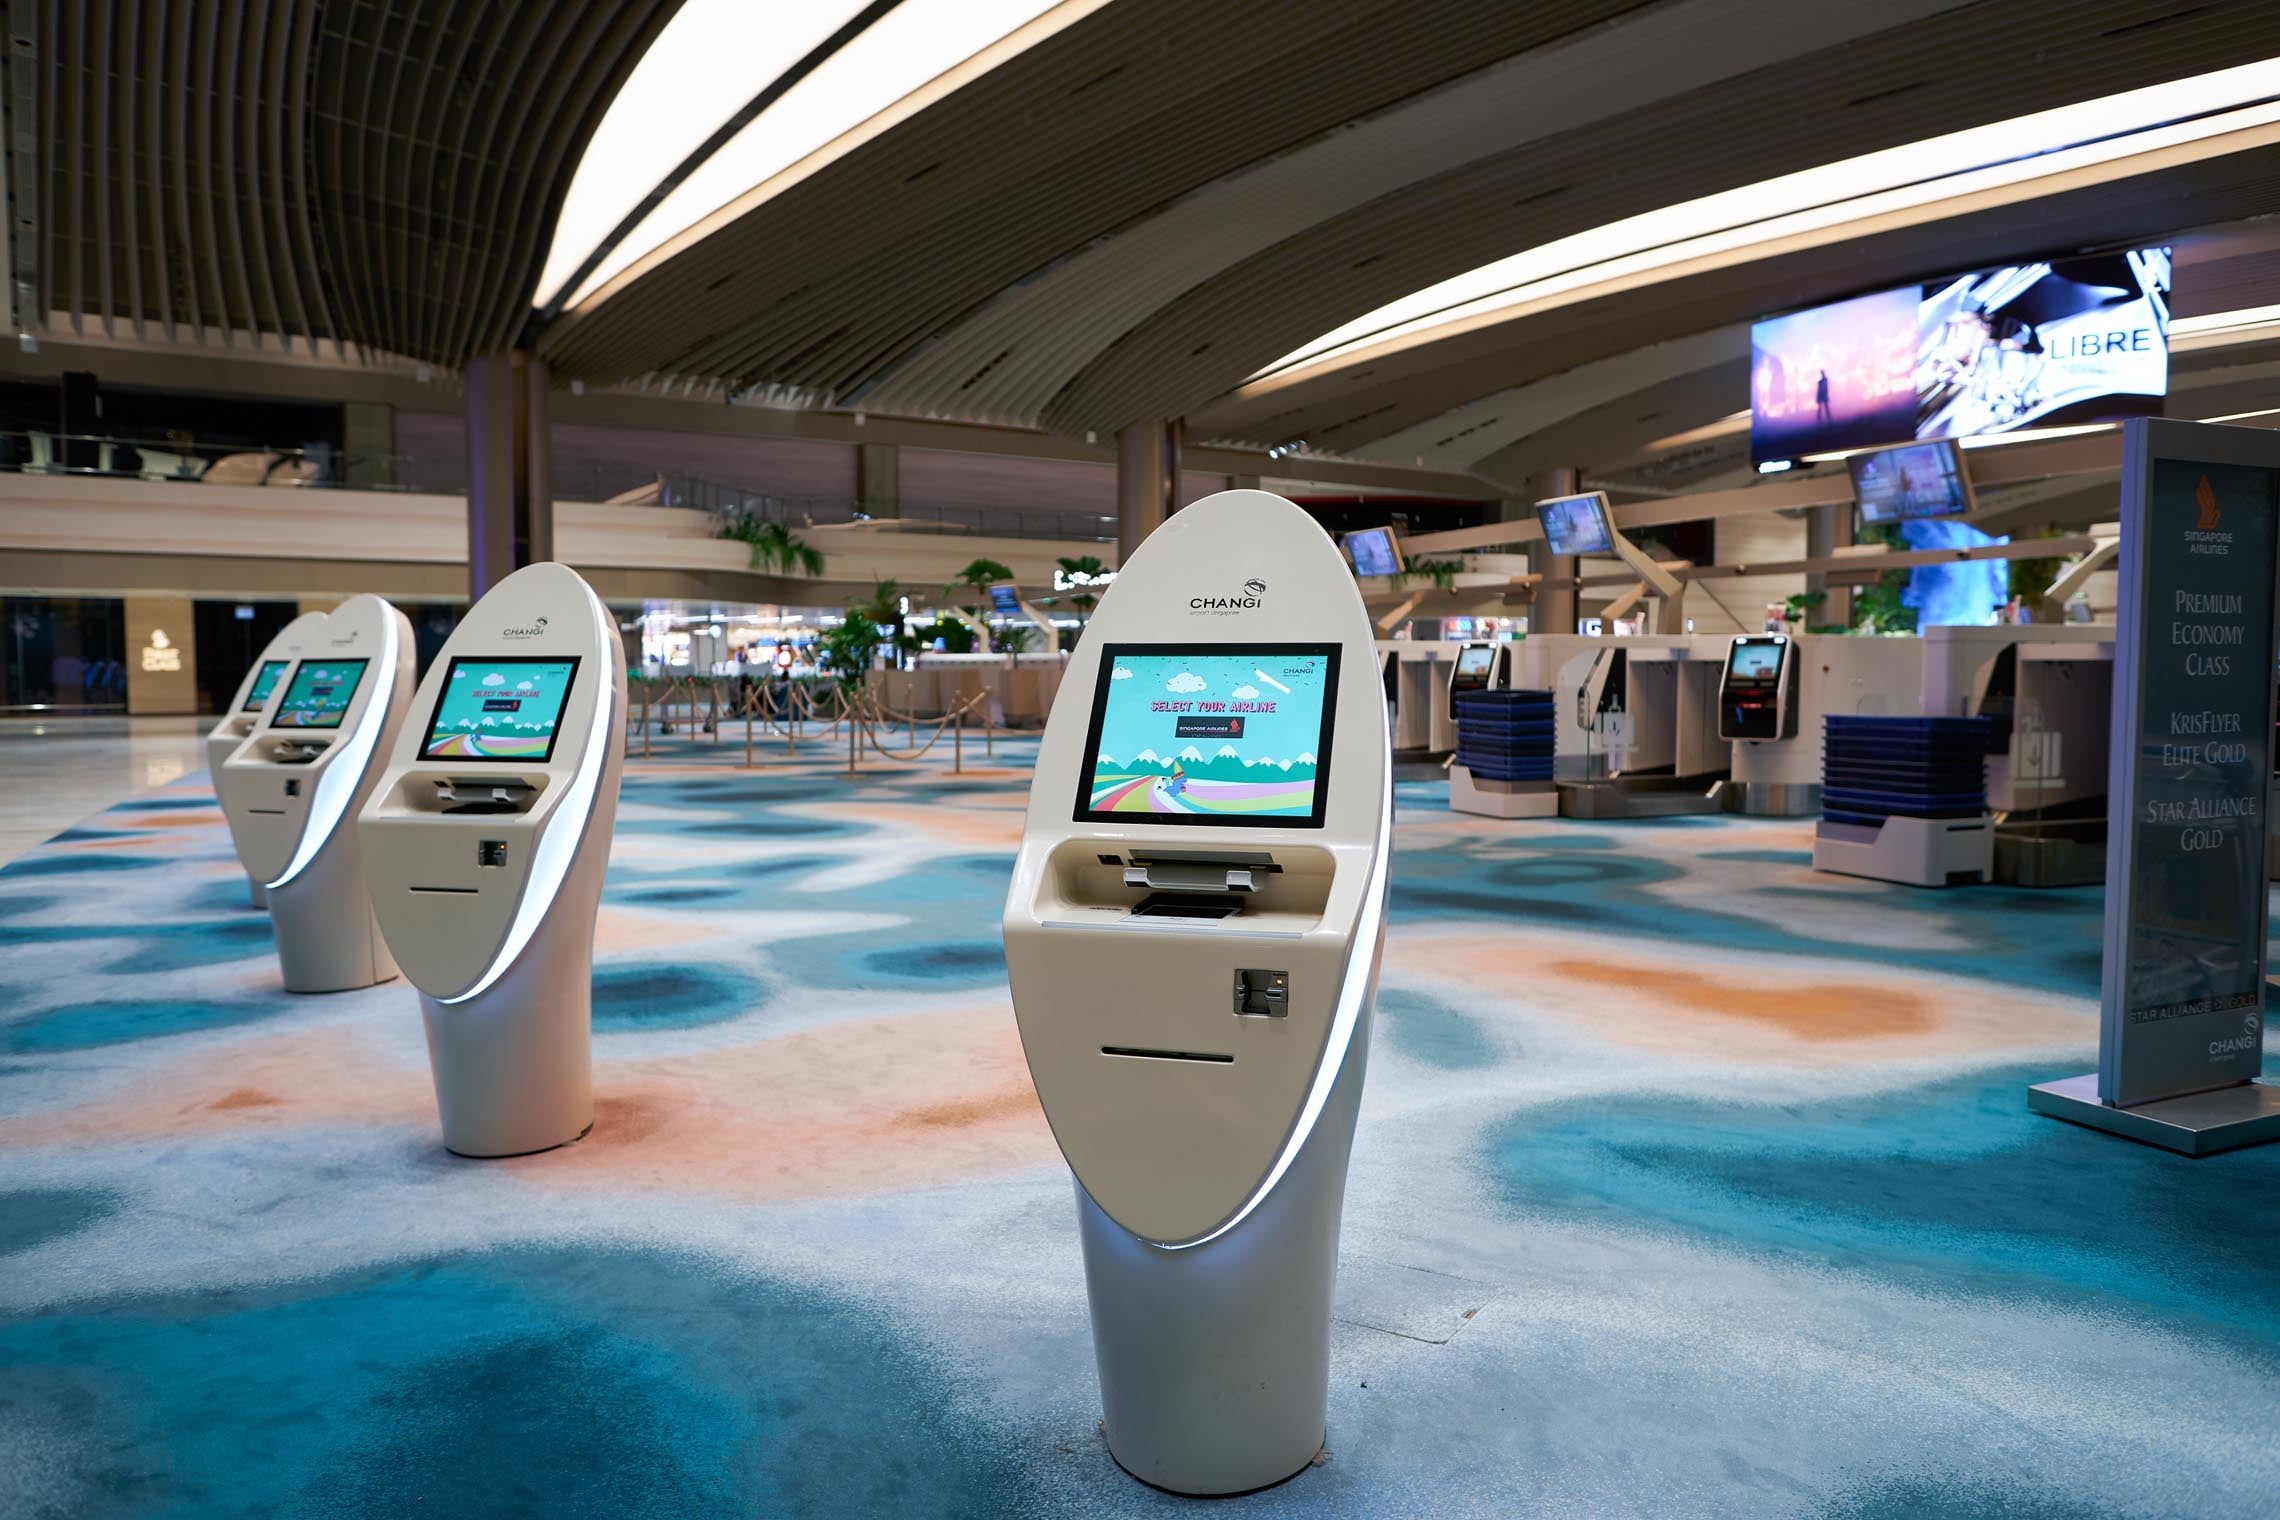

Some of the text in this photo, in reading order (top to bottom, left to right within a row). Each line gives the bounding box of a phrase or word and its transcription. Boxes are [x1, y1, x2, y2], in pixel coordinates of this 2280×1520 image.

[2051, 328, 2151, 359] LIBRE
[2184, 531, 2233, 543] SINGAPORE
[2189, 543, 2229, 555] AIRLINES
[1190, 597, 1262, 609] CHANGI
[2175, 590, 2242, 614] PREMIUM
[503, 628, 545, 636] CHANGI
[2172, 622, 2245, 645] ECONOMY
[2185, 652, 2231, 677] CLASS
[1151, 701, 1277, 713] SELECT YOUR AIRLINE
[2163, 741, 2247, 767] ELITE GOLD
[2147, 797, 2257, 823] STAR ALLIANCE
[2180, 828, 2224, 851] GOLD
[2128, 1009, 2158, 1024] STAR
[2159, 999, 2213, 1018] ALLIANCE
[2208, 1036, 2257, 1055] CHANGI
